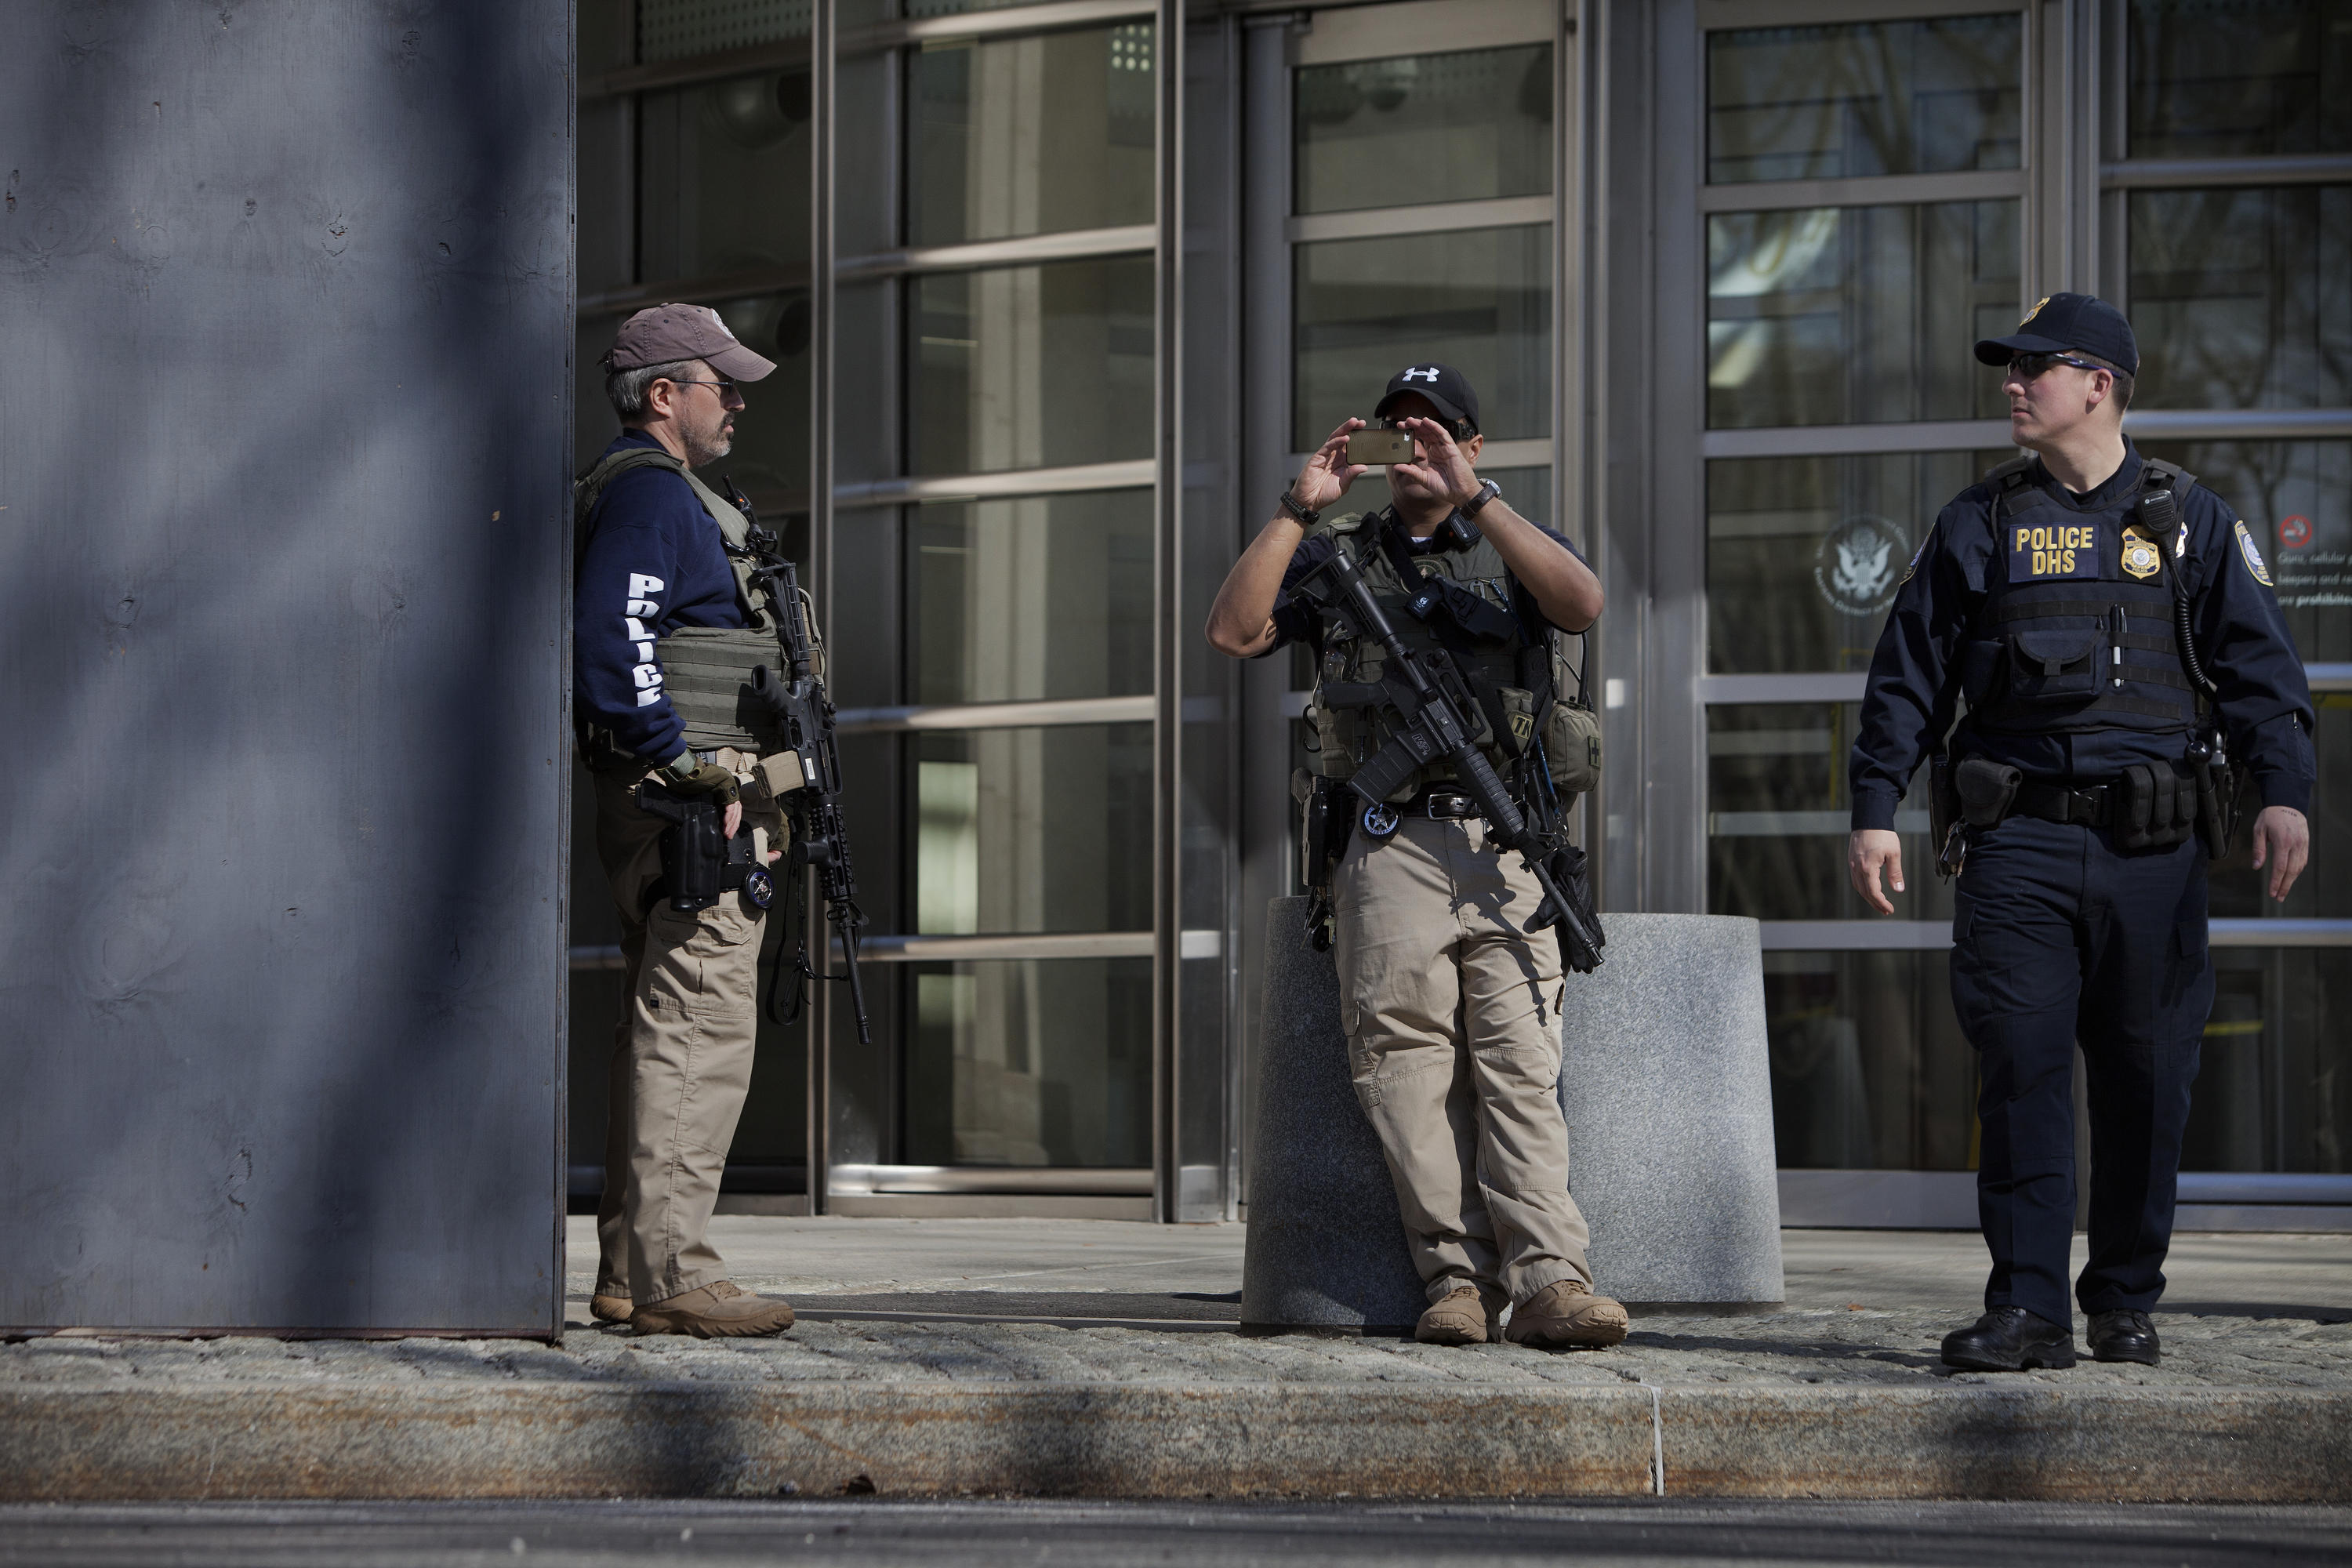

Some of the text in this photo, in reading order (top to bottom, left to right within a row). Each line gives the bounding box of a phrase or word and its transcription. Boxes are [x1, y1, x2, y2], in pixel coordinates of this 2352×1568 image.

[2016, 526, 2093, 552] POLICE
[2032, 550, 2075, 575] DHS
[2296, 592, 2352, 609] prohibite
